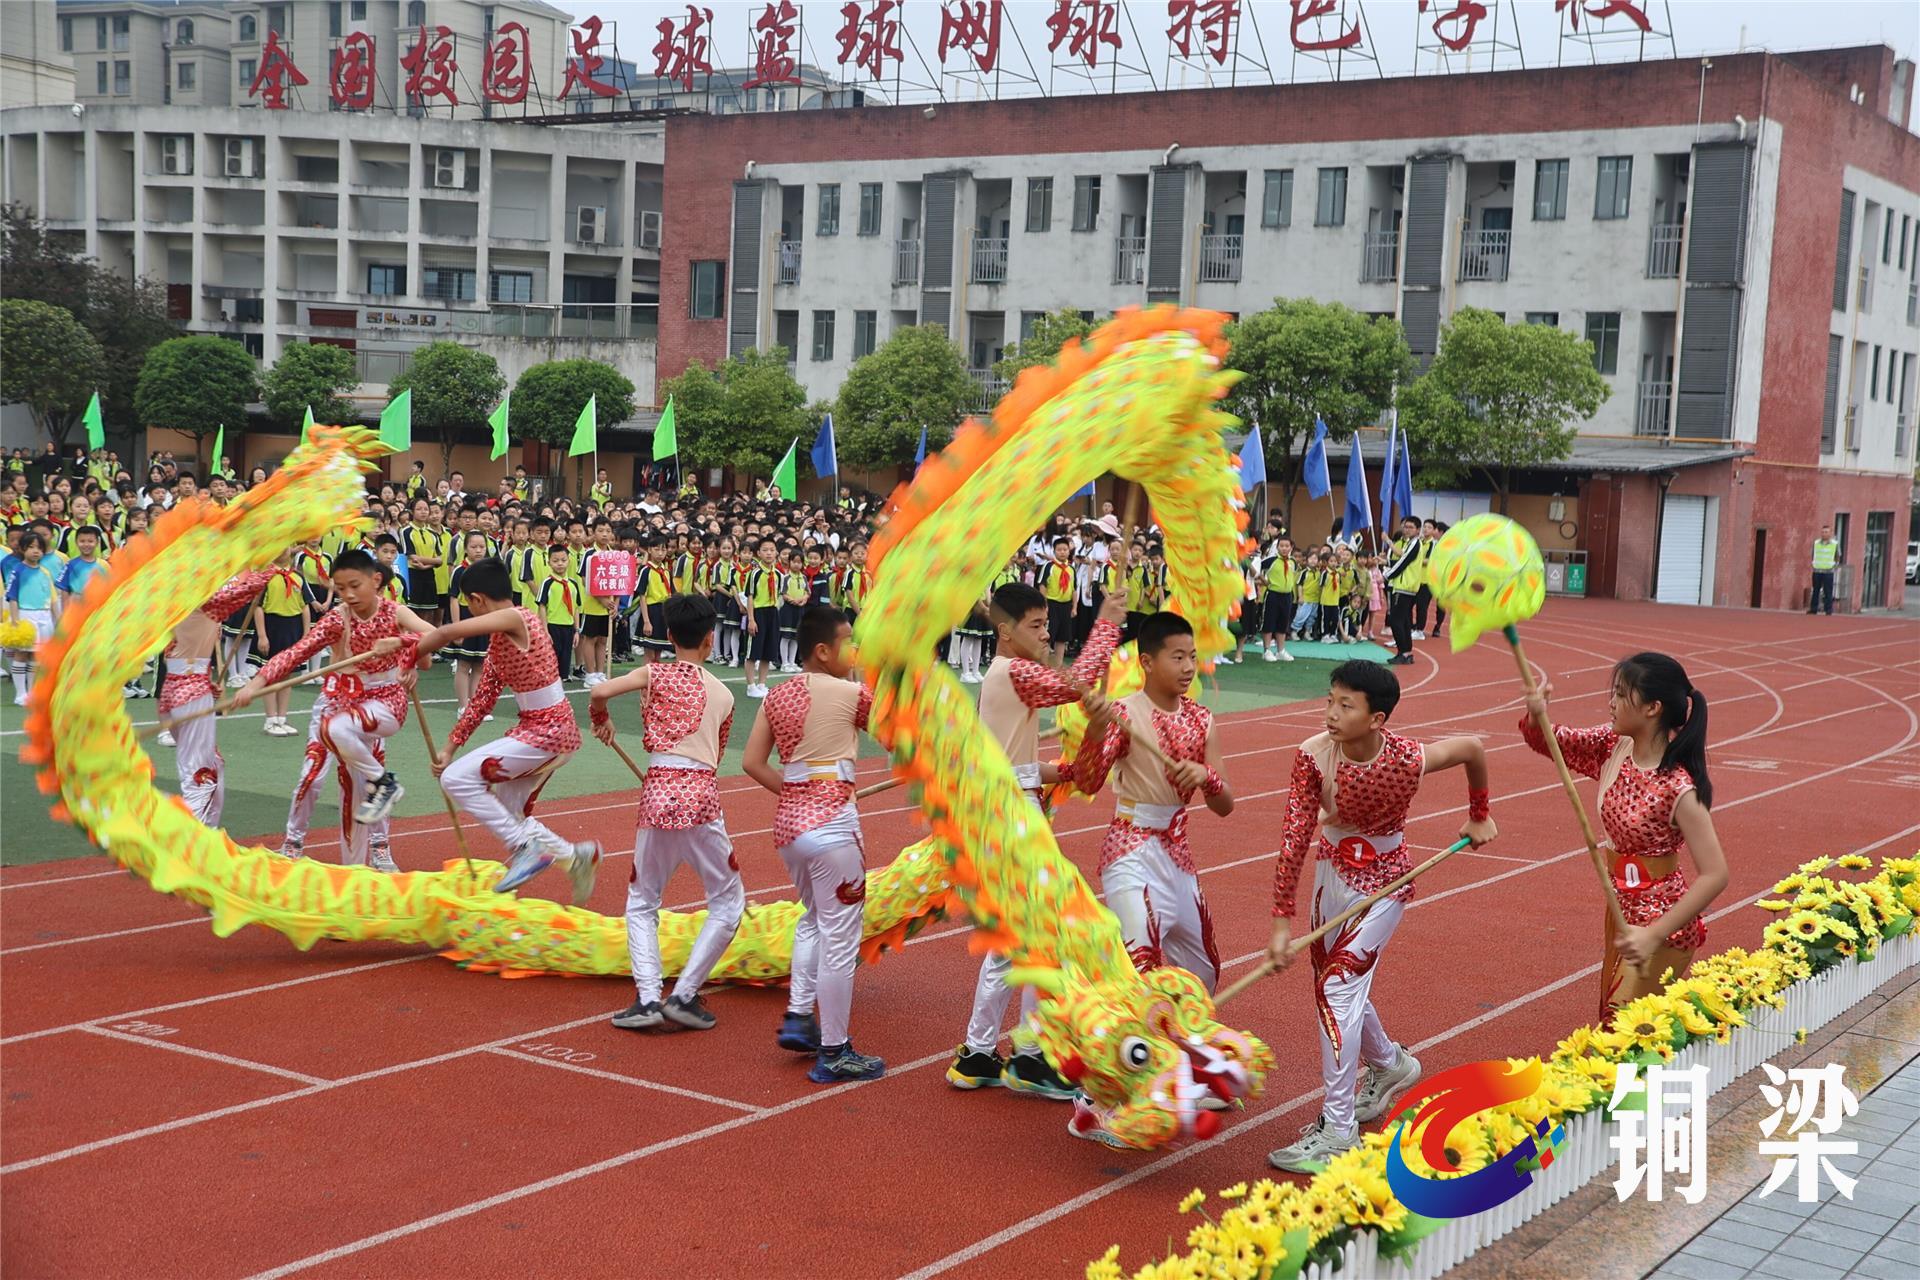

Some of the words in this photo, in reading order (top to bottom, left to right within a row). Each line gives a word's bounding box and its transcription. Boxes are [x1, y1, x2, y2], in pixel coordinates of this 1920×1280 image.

[596, 564, 630, 577] 六年级
[598, 578, 627, 591] 代表队
[1351, 843, 1363, 862] 1
[1624, 862, 1641, 888] 0
